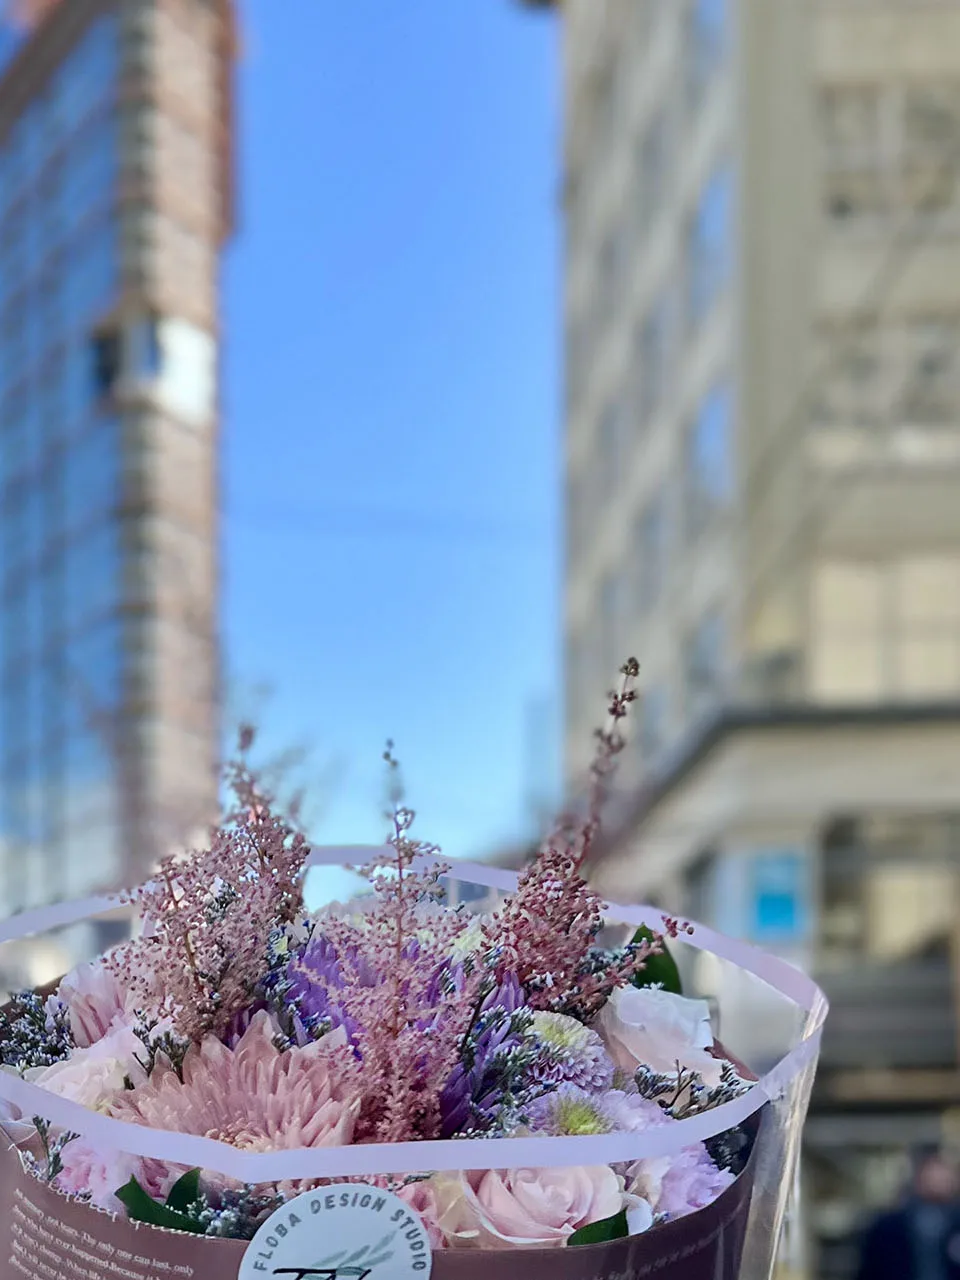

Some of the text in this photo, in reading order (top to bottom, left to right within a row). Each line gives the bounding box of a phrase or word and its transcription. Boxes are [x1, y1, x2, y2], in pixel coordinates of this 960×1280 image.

[253, 1192, 427, 1272] FLOBA DESIGN STUDIO
[134, 1255, 150, 1266] can
[173, 1263, 194, 1277] only
